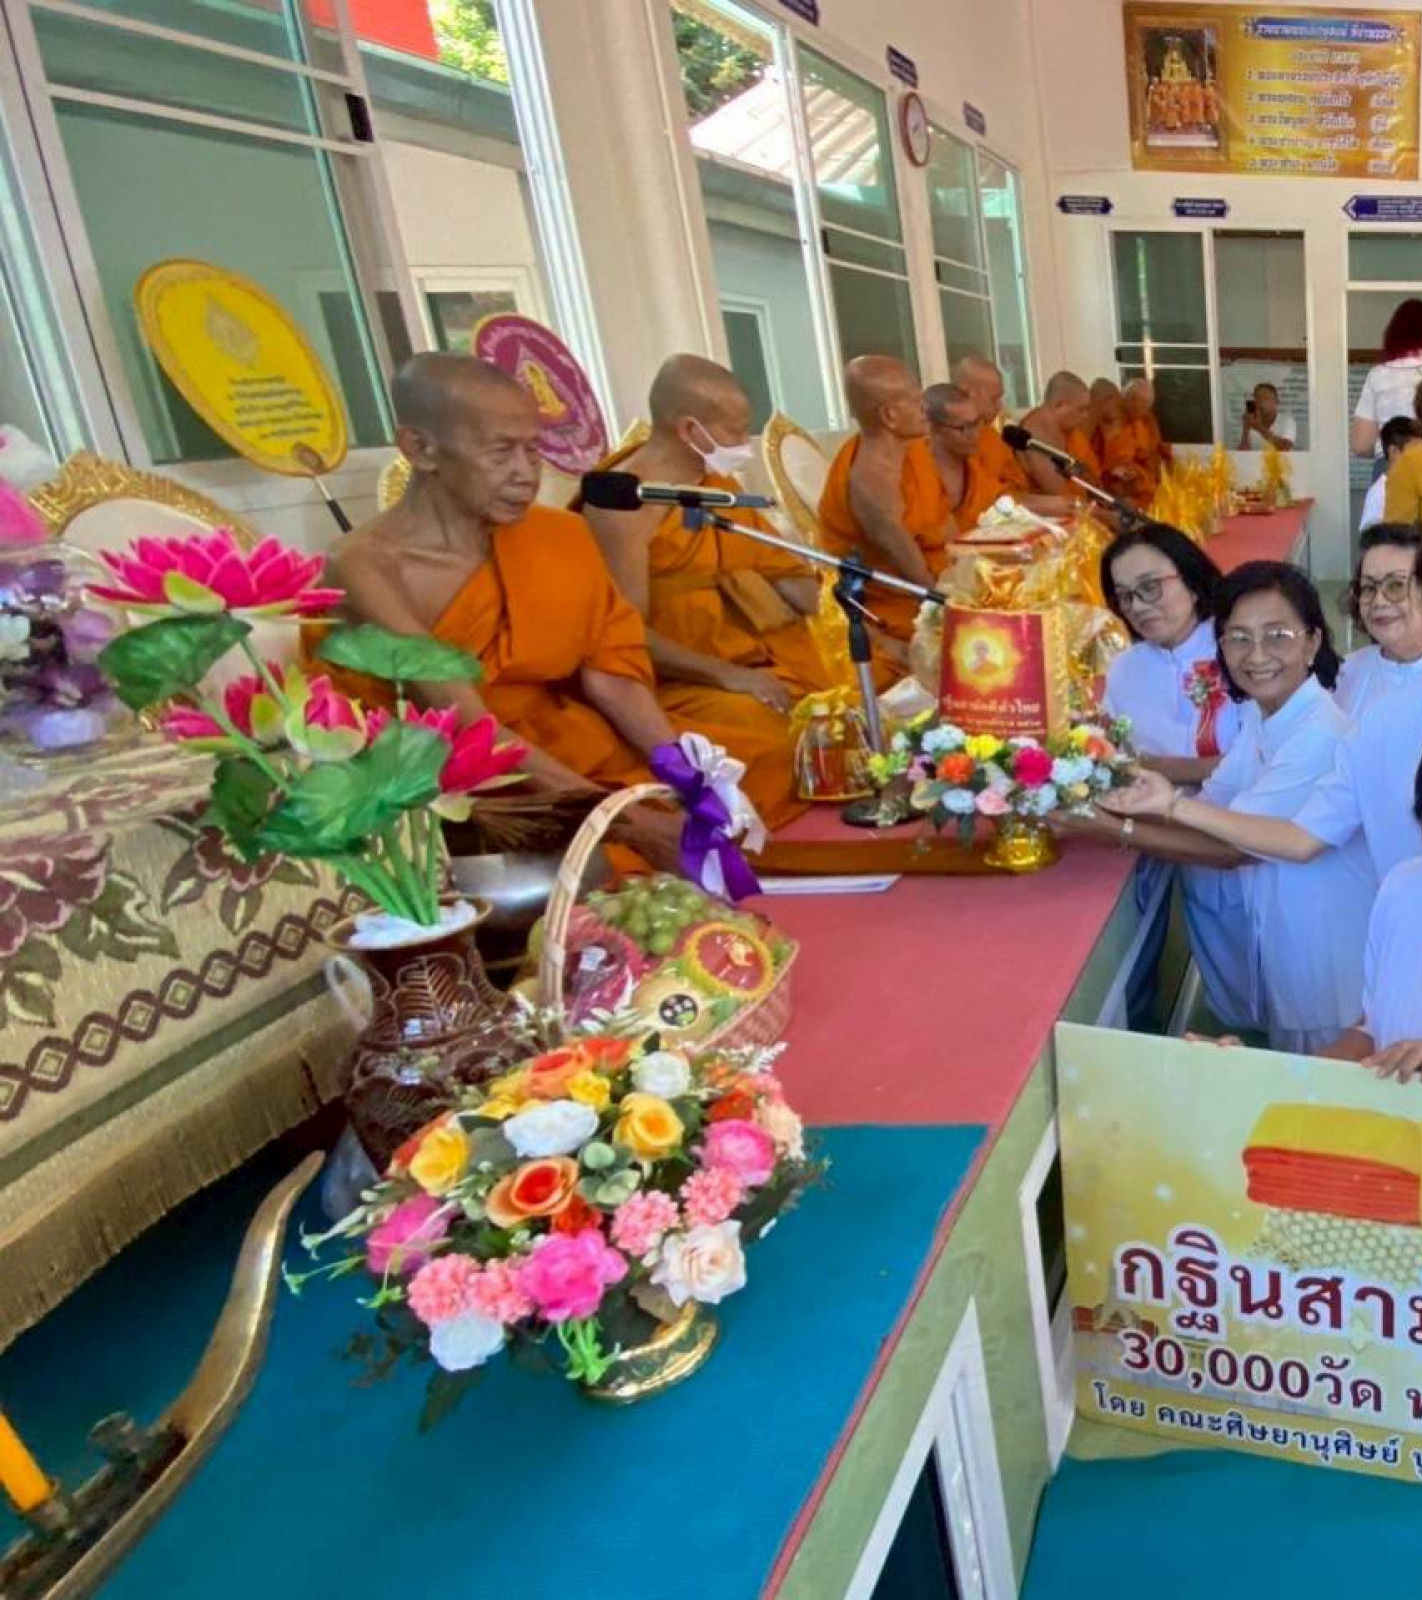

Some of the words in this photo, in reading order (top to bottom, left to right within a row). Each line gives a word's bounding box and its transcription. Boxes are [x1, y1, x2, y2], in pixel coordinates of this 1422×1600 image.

[1122, 1332, 1383, 1413] 30,000วัด
[1094, 1382, 1146, 1417] โดย
[1158, 1403, 1400, 1464] คณะศิษยานุศิษย์
